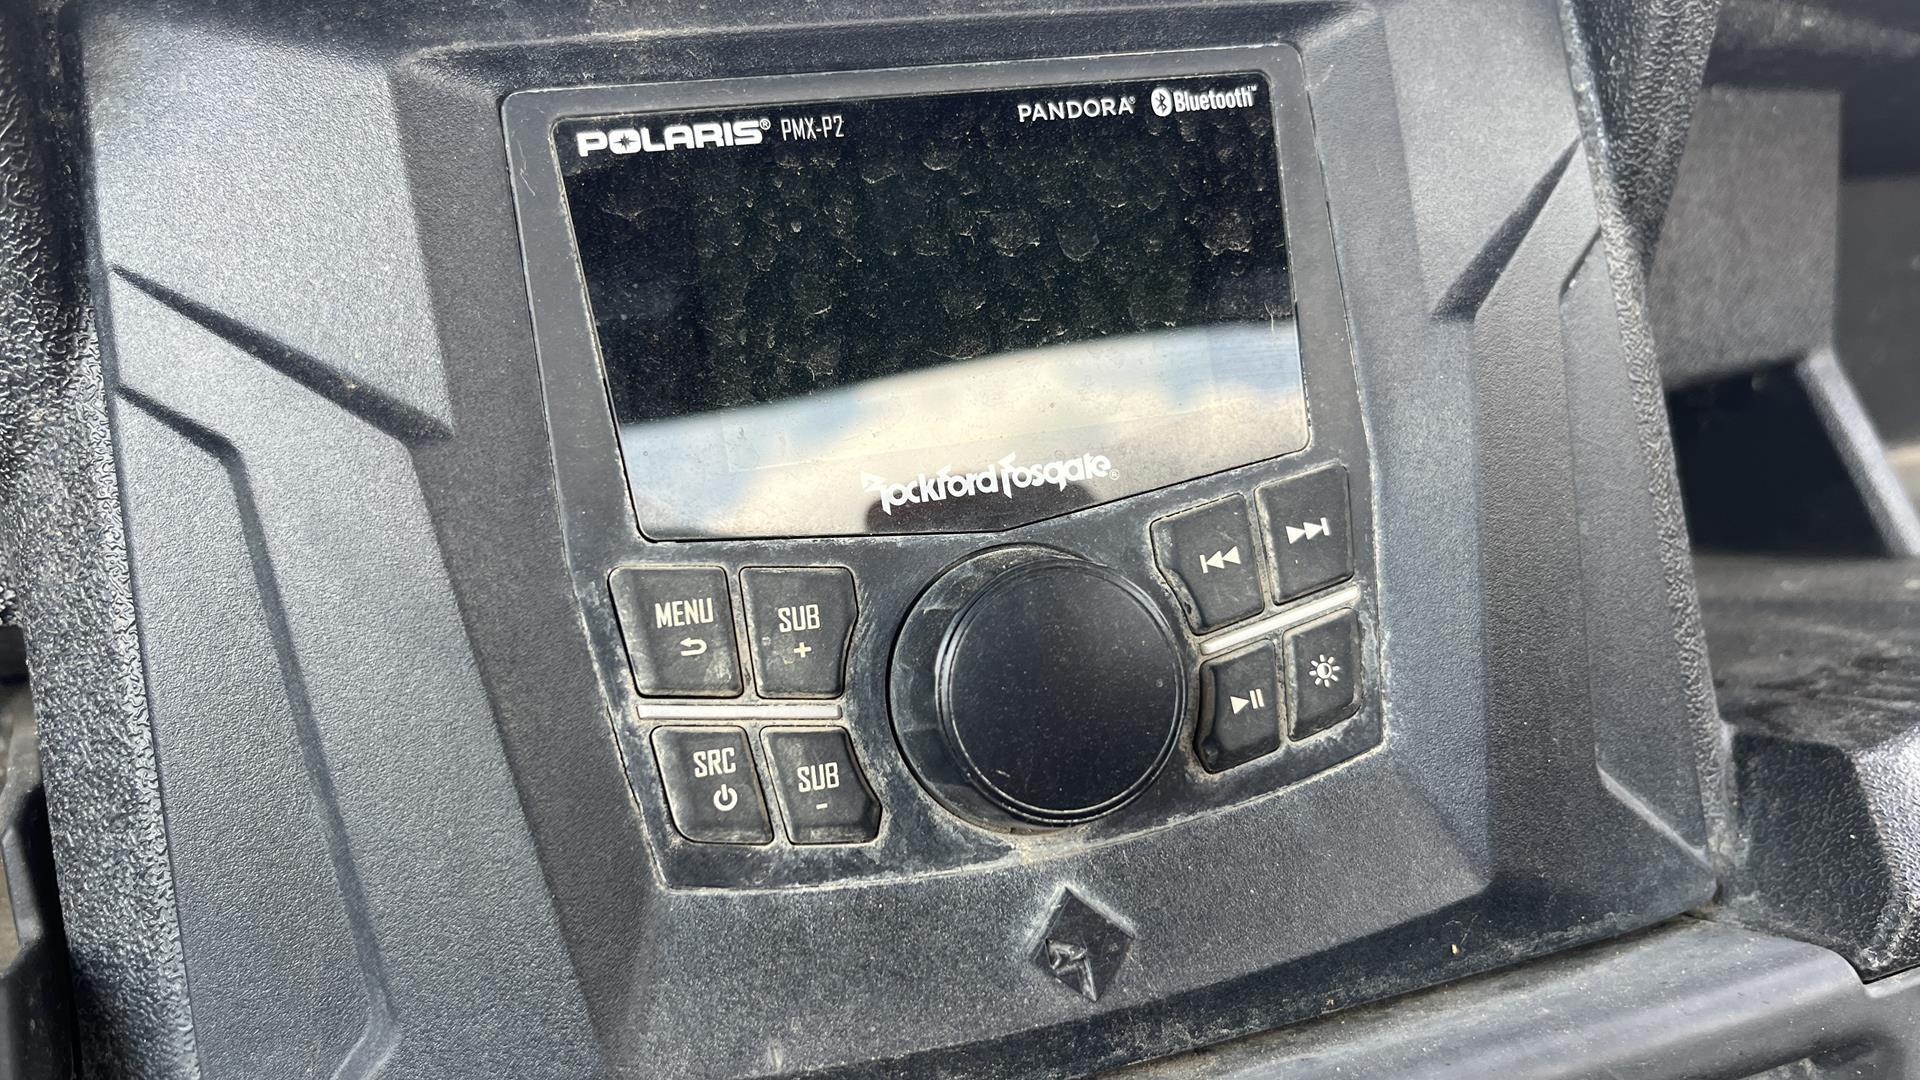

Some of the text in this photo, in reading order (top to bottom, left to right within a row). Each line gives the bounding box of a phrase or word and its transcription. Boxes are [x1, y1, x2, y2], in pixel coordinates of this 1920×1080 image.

[781, 115, 845, 141] PMX-P2
[860, 464, 998, 516] Rockford
[655, 598, 713, 628] MENU
[778, 604, 820, 632] SUB
[693, 747, 736, 777] SRC
[797, 762, 839, 792] SUB
